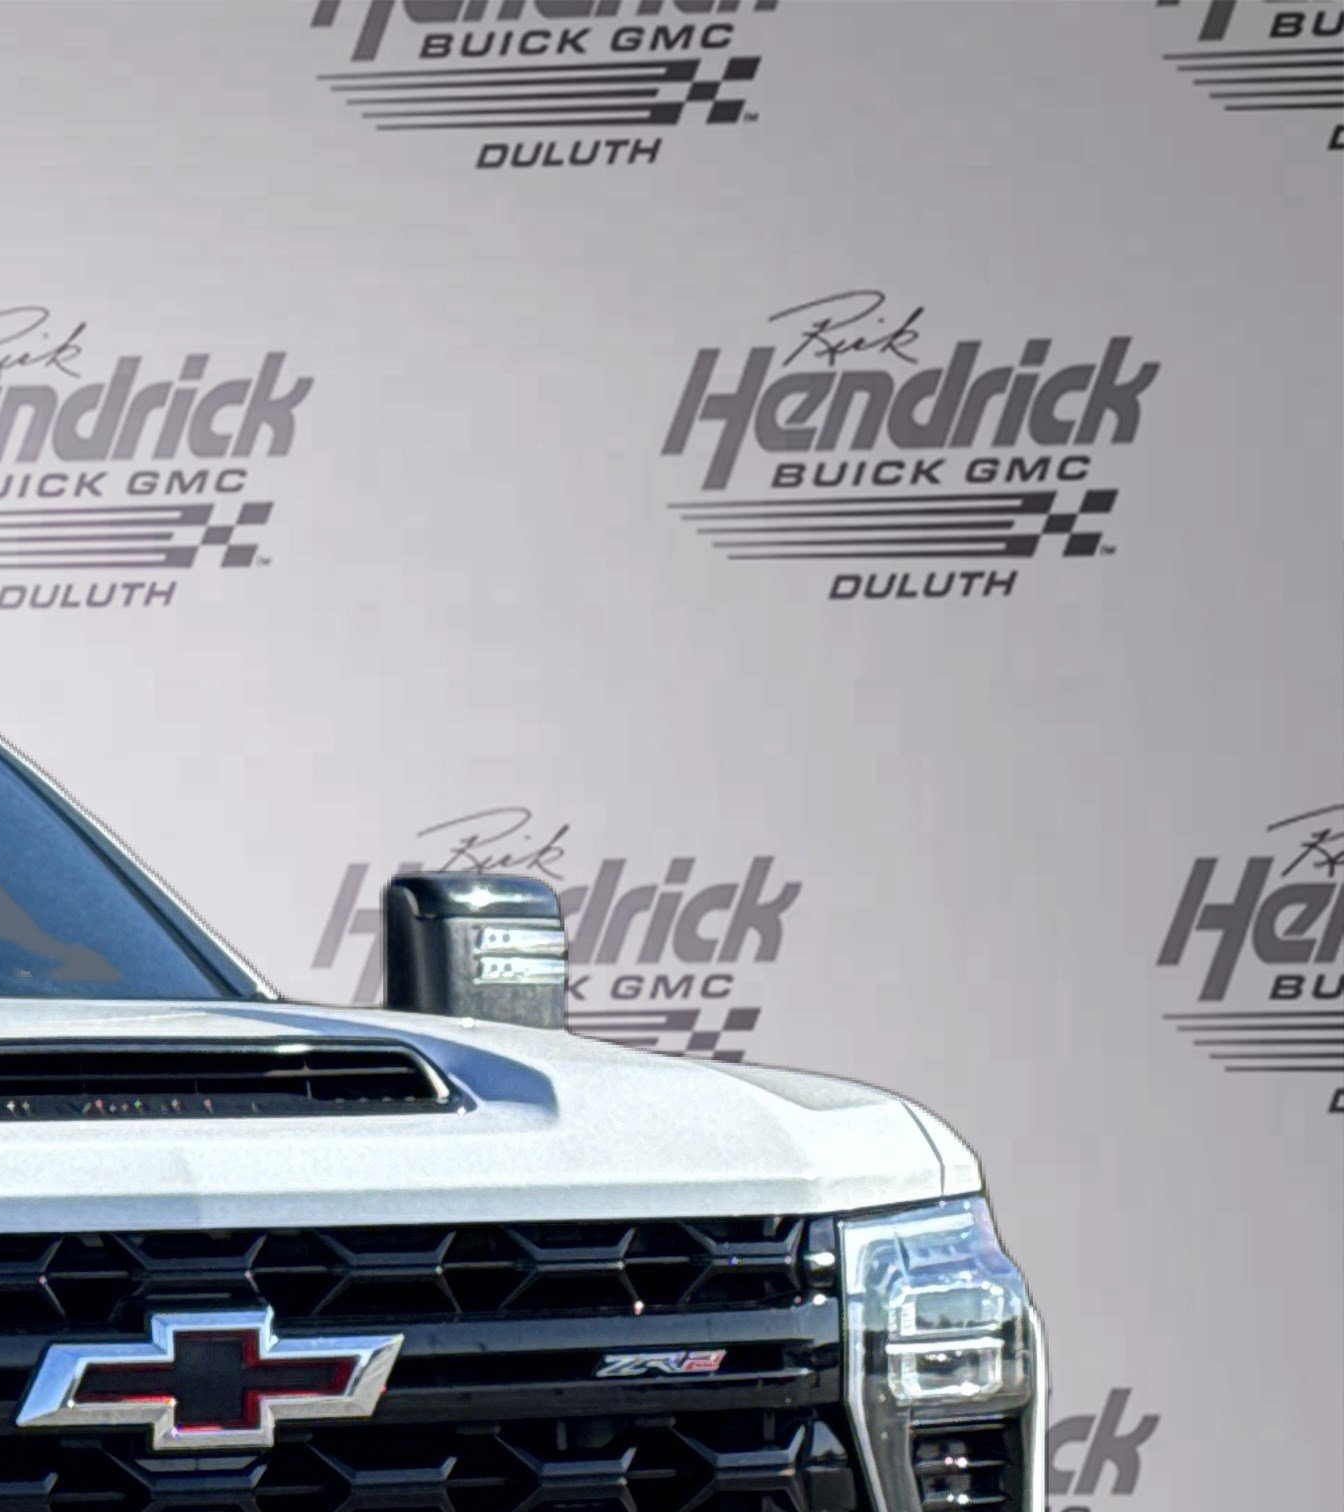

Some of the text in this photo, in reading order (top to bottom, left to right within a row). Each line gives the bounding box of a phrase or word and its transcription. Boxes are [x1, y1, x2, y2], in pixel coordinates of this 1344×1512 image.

[420, 28, 591, 58] BUICK
[611, 23, 734, 52] GMC
[476, 138, 662, 169] DULUTH
[660, 336, 1160, 490] Hendrick
[127, 468, 247, 495] GMC
[772, 455, 1091, 488] BUICK GMC
[829, 570, 1018, 600] DULUTH
[312, 855, 803, 1004] Hdrick
[611, 974, 734, 1000] GMC
